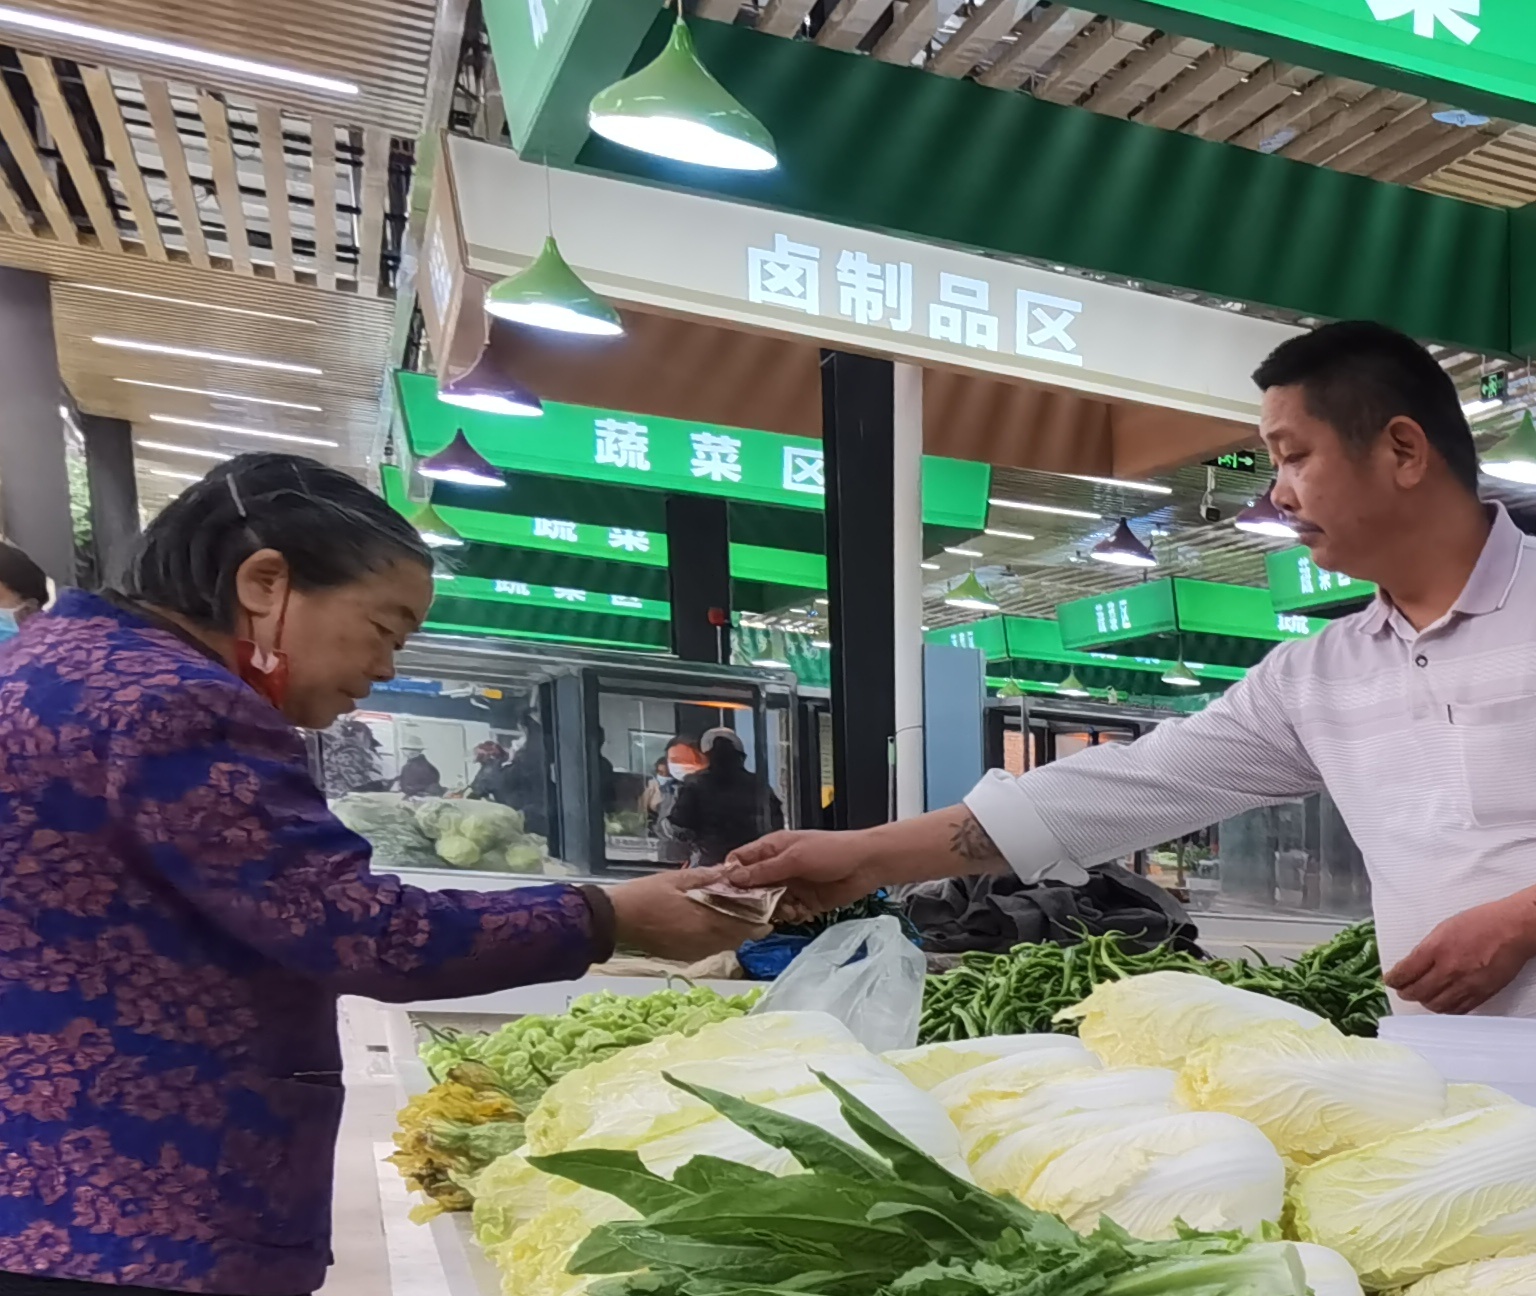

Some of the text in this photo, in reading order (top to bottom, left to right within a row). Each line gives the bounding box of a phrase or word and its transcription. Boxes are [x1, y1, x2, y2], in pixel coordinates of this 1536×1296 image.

[747, 233, 1083, 367] 卤制品区
[594, 418, 824, 494] 蔬菜区
